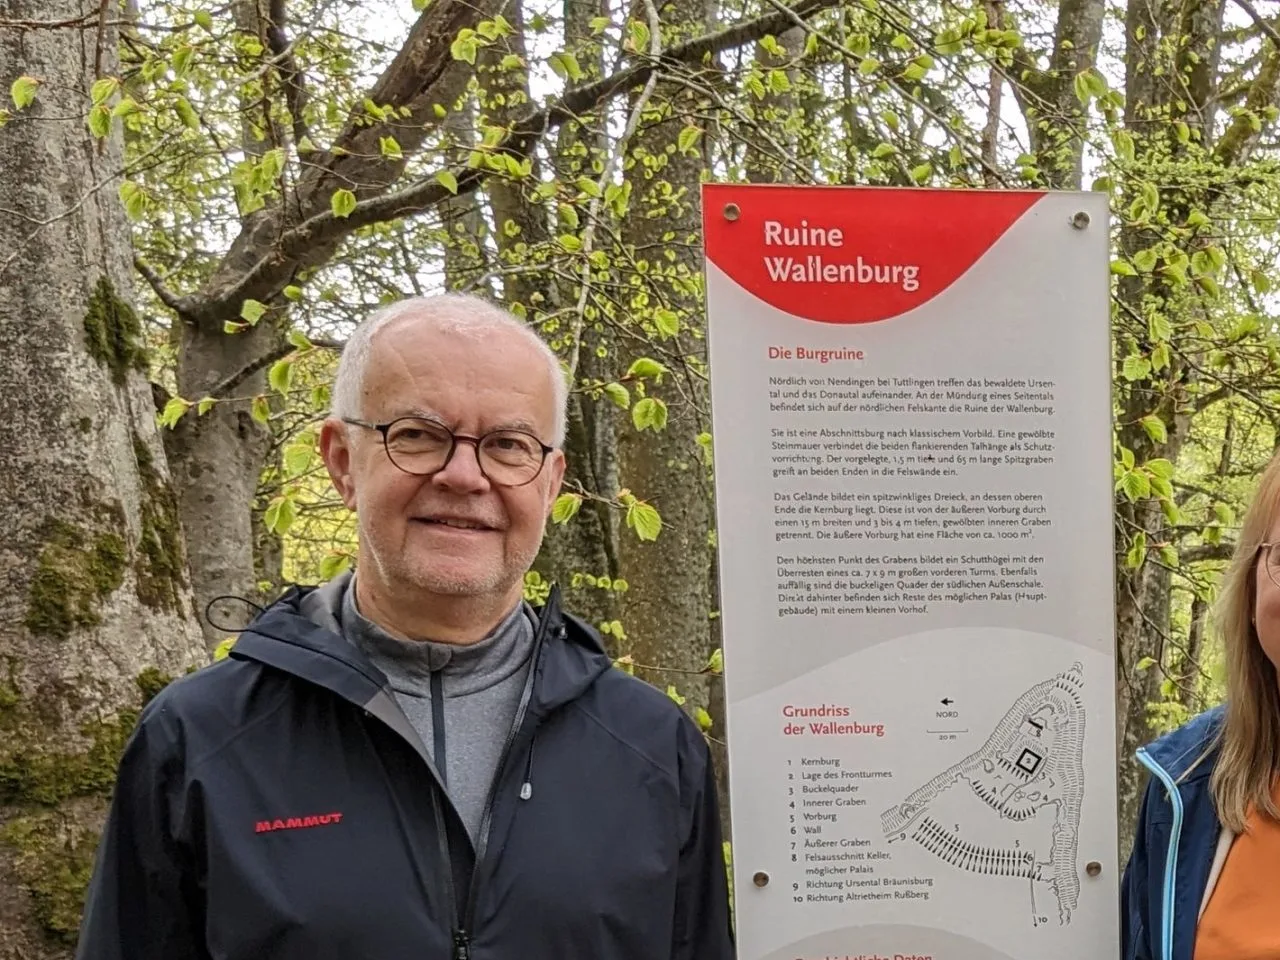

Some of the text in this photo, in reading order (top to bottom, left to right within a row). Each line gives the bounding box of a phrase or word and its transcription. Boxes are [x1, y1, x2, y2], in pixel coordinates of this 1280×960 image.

[764, 221, 842, 246] Ruine
[764, 256, 919, 290] Wallenburg
[768, 346, 863, 363] Die Burgruine
[769, 376, 806, 385] Nördlich
[827, 377, 875, 388] Nendingen
[877, 377, 890, 386] bei
[892, 377, 935, 388] Tuttlingen
[936, 377, 964, 386] treffen
[966, 377, 981, 387] das
[983, 378, 1026, 387] bewaldete
[1027, 379, 1055, 387] Ursen-
[771, 428, 1054, 440] Sie ist eine Abschnittsburg nach klassischem Vorbild. Eine gewölbte
[774, 492, 790, 500] Das
[792, 491, 828, 500] Gelände
[830, 492, 854, 501] bildet
[872, 492, 931, 503] spitzwinkliges
[934, 492, 968, 501] Dreieck,
[982, 492, 1012, 501] dessen
[1014, 492, 1042, 500] oberen
[777, 579, 1043, 591] auffällig sind die buckeligen Quader der südlichen Außenschale.
[782, 704, 849, 716] Grundriss
[783, 722, 884, 736] der Wallenburg
[801, 757, 840, 767] Kernburg
[801, 772, 821, 781] Lage
[823, 770, 839, 779] des
[788, 784, 858, 795] 3 Buckelquader
[835, 797, 866, 806] Graben
[255, 812, 343, 833] MAMMUT
[789, 812, 837, 823] 5 Vorburg
[790, 825, 821, 834] 6 Wall
[790, 838, 870, 850] 7 Äußerer Graben
[791, 853, 797, 862] 8
[804, 852, 864, 861] Felsausschnitt
[805, 865, 873, 876] möglicher Palais
[792, 876, 933, 891] 9 Richtung Ursental Bräunisburg
[806, 893, 844, 903] Richtung
[894, 890, 929, 900] Rußberg
